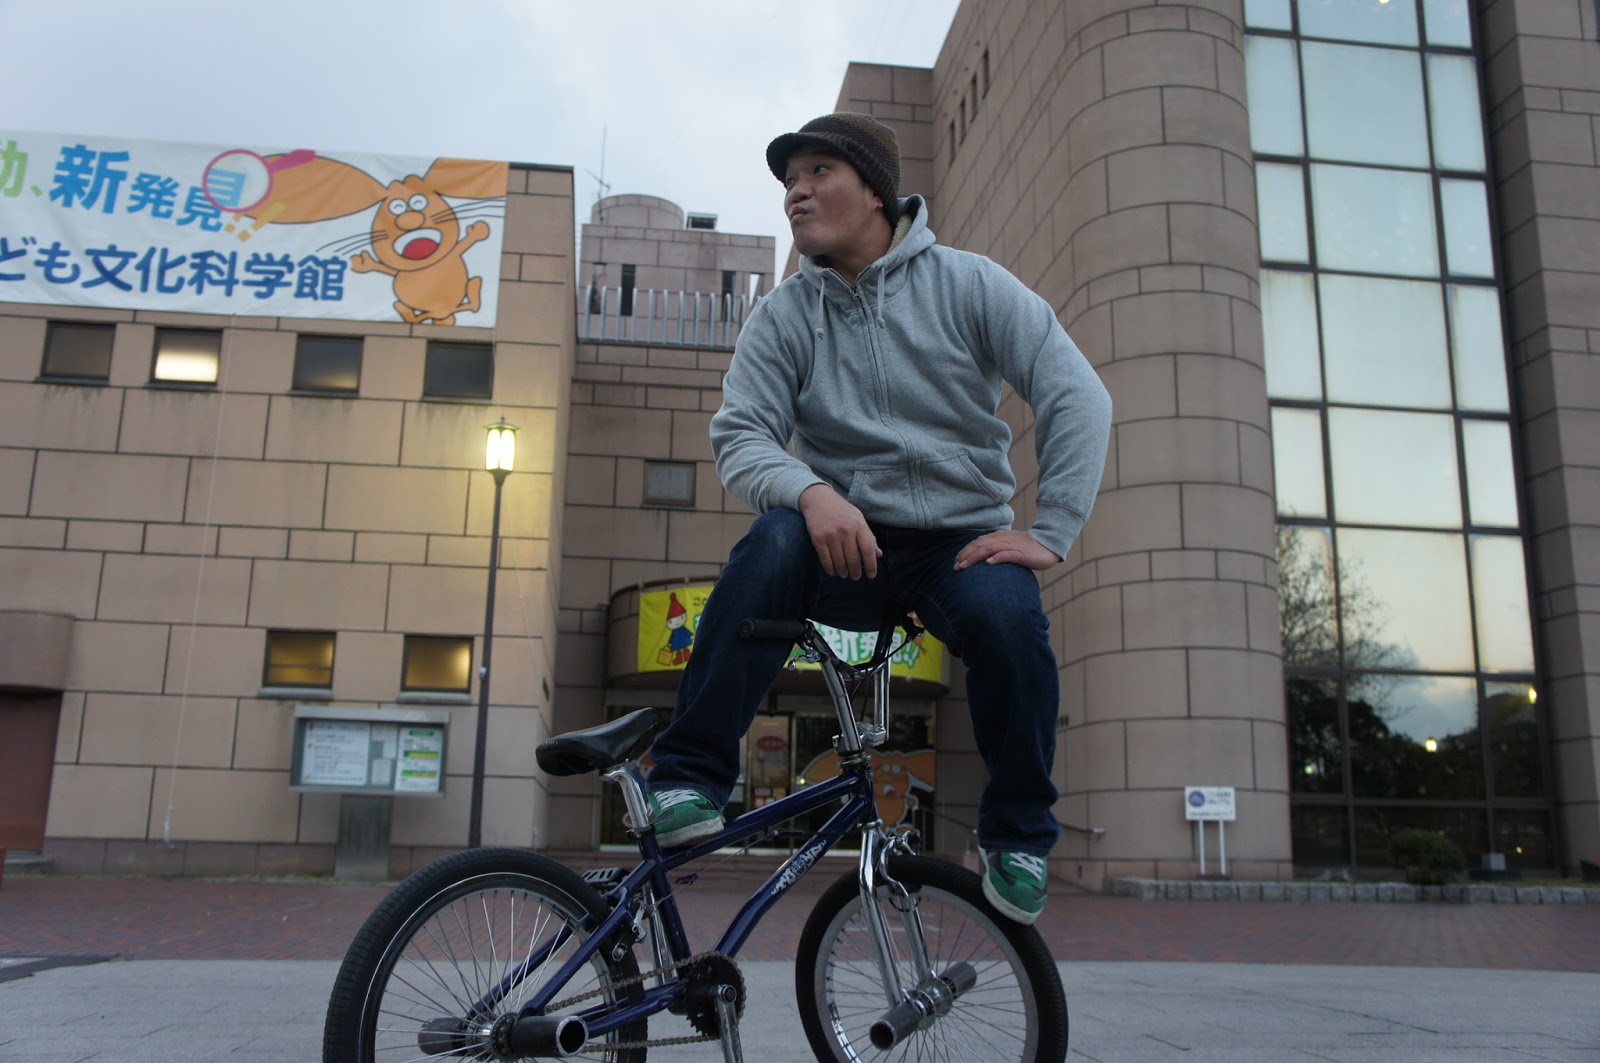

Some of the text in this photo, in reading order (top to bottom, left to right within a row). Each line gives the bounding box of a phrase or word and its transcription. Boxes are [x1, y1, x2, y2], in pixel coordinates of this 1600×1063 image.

[0, 236, 348, 301] ども文化科学館
